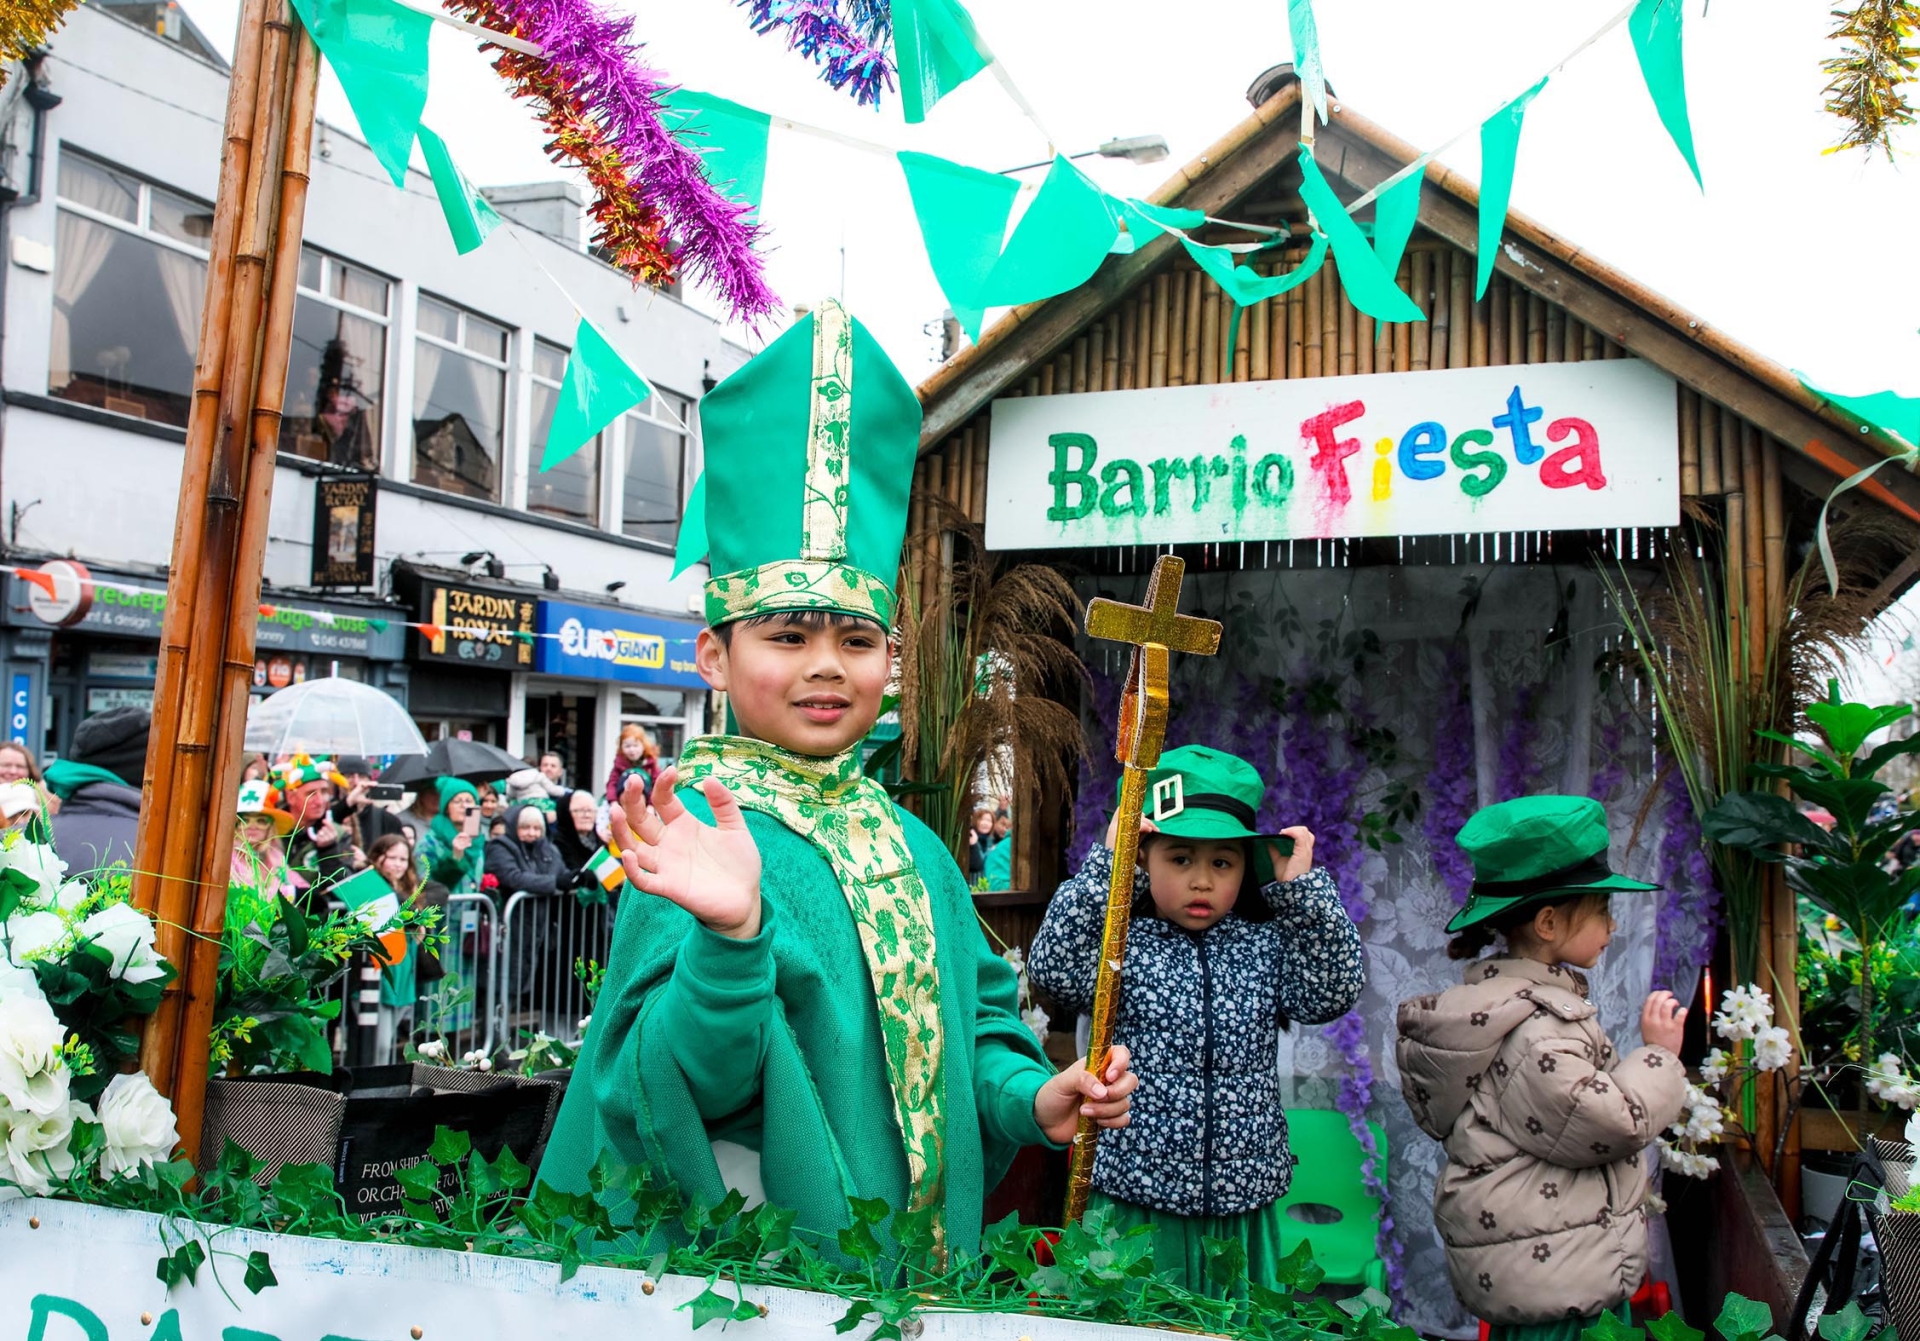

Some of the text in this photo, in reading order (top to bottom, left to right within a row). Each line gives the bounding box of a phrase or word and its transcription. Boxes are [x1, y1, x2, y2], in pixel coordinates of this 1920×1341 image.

[1046, 385, 1607, 522] Barrio Fiesta
[449, 590, 516, 619] JARDIN
[102, 611, 112, 625] &
[114, 613, 151, 630] design
[453, 617, 513, 646] ROYAL
[361, 1161, 398, 1178] FROM
